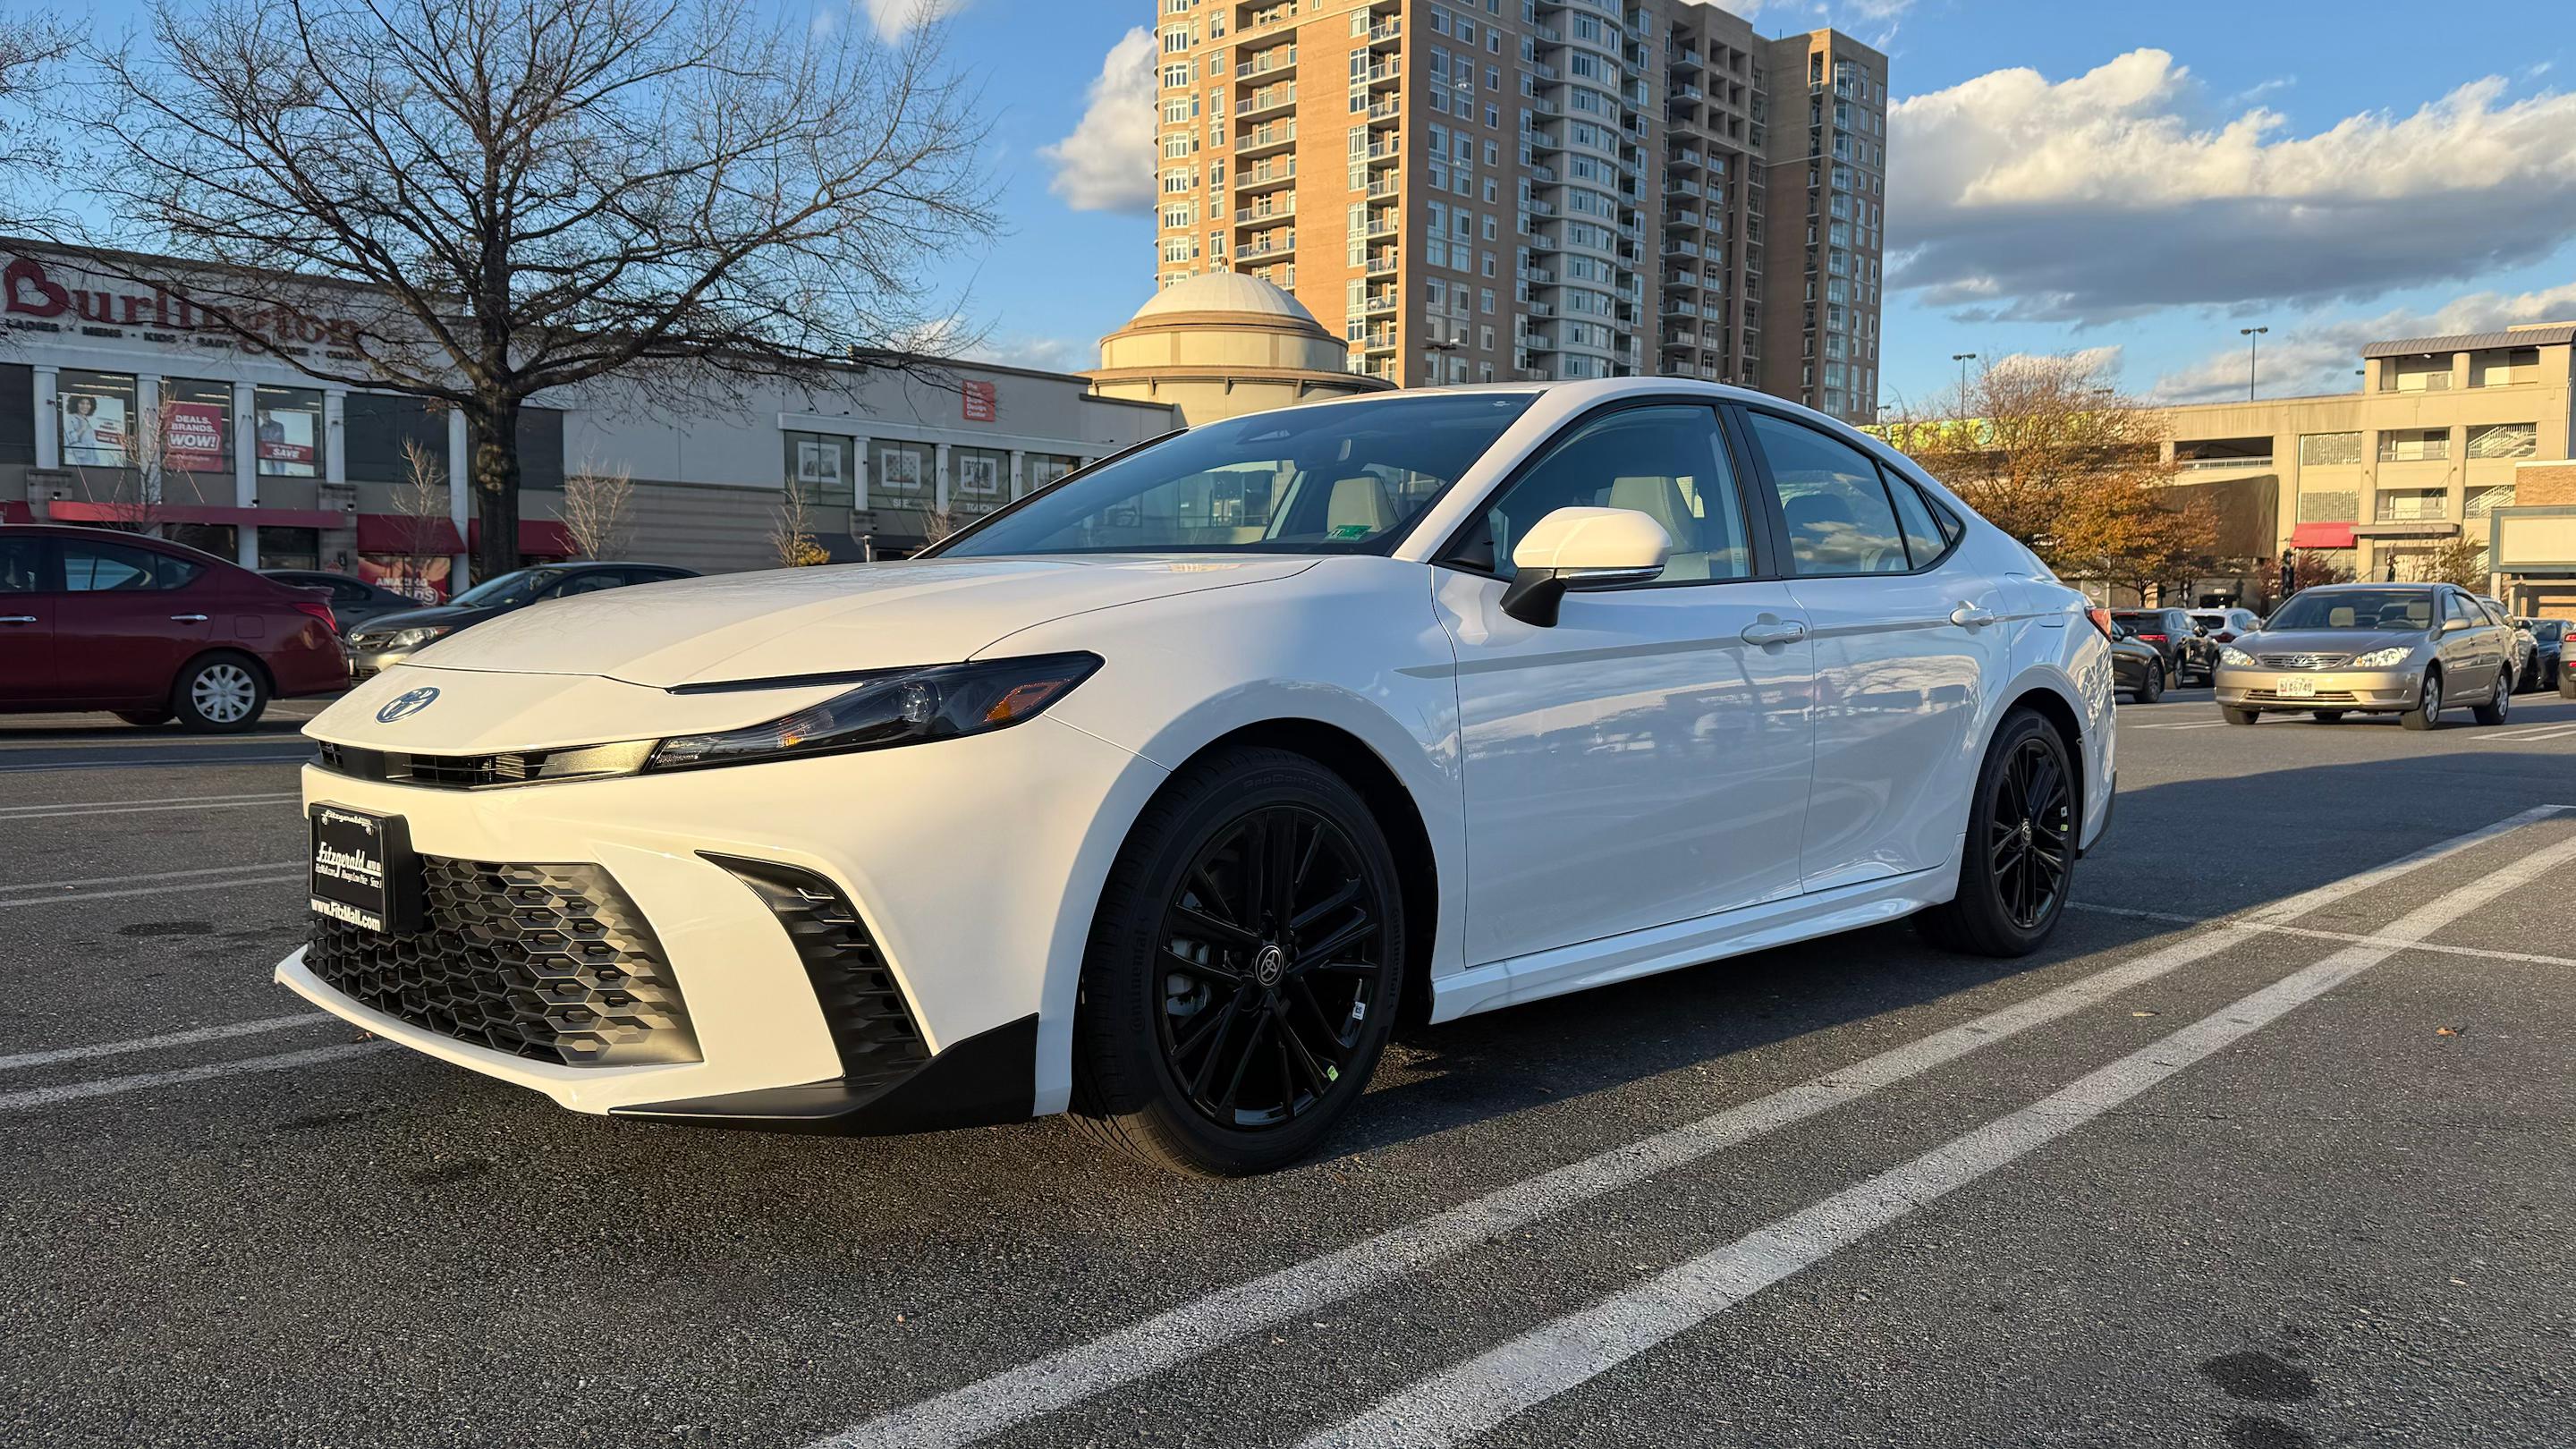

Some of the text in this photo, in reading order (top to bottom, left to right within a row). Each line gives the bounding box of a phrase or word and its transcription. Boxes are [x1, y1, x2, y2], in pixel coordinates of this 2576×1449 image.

[4, 258, 360, 354] Burlington
[171, 422, 216, 433] BRANDS.
[169, 433, 216, 448] WOW!
[272, 448, 300, 459] SAVE
[316, 841, 366, 878] Fitzgerald
[310, 898, 381, 932] www.FitzMall.com
